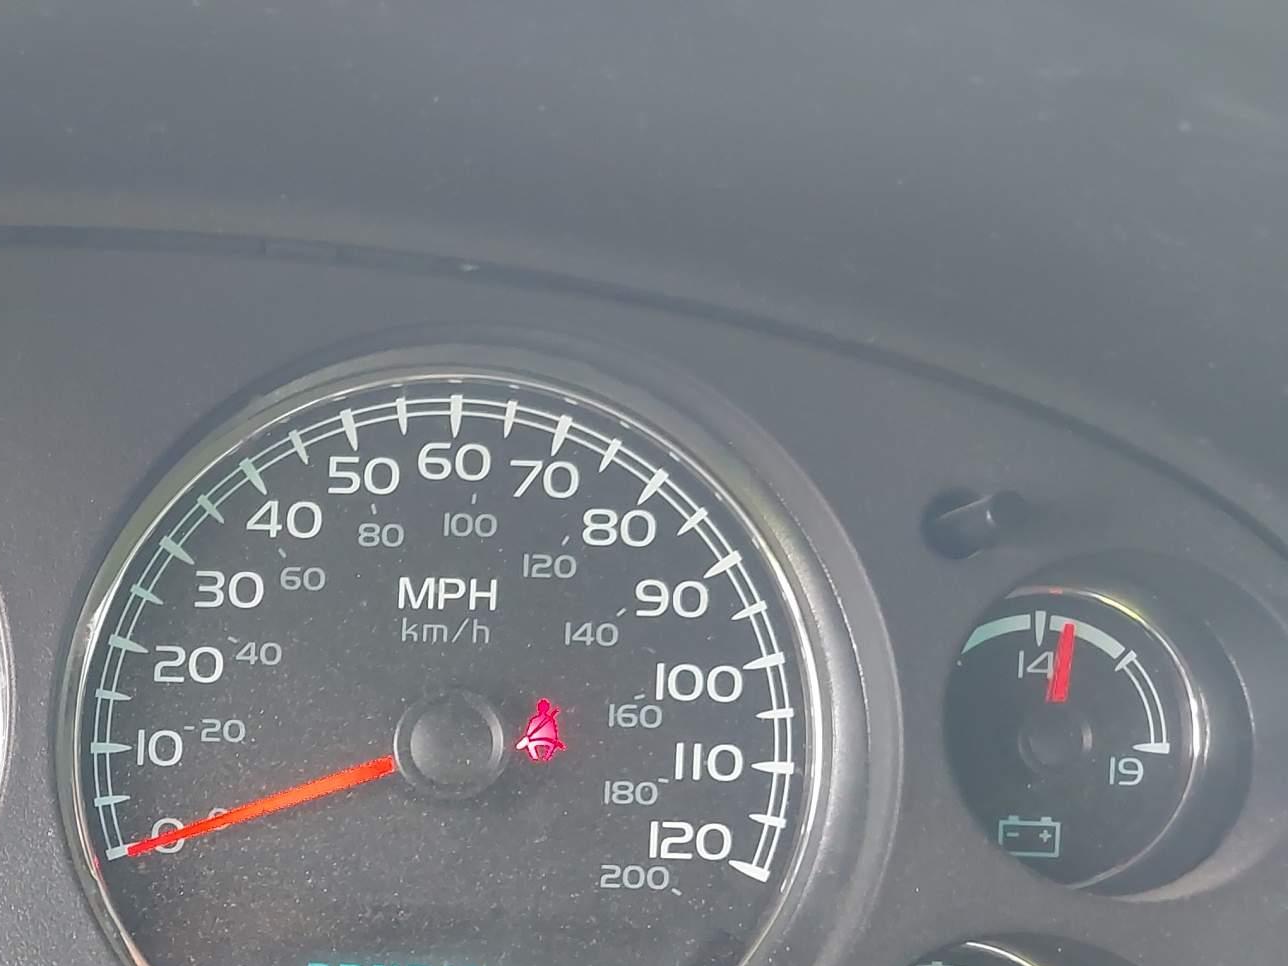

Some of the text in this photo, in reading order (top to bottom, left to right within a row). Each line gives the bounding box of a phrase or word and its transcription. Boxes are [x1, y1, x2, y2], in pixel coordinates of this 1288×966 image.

[327, 456, 401, 495] 50
[417, 442, 492, 482] 60
[510, 459, 580, 499] 70
[245, 500, 323, 539] 40
[358, 522, 405, 548] 80
[443, 512, 498, 538] 100
[582, 508, 657, 547] 80
[280, 566, 326, 592] 60
[522, 553, 578, 579] 120
[193, 569, 265, 609] 30
[397, 576, 499, 612] MPH
[634, 578, 710, 619] 90
[401, 617, 491, 644] km/h
[564, 621, 620, 648] 140
[153, 645, 225, 684] 20
[235, 641, 283, 666] 40
[1017, 649, 1056, 679] 14
[655, 662, 744, 703] 100
[200, 718, 246, 743] 20
[608, 703, 662, 729] 160
[136, 728, 184, 767] 10
[674, 741, 744, 782] 110
[1108, 756, 1144, 786] 19
[603, 780, 659, 806] 180
[648, 820, 732, 861] 120
[600, 864, 669, 890] 200
